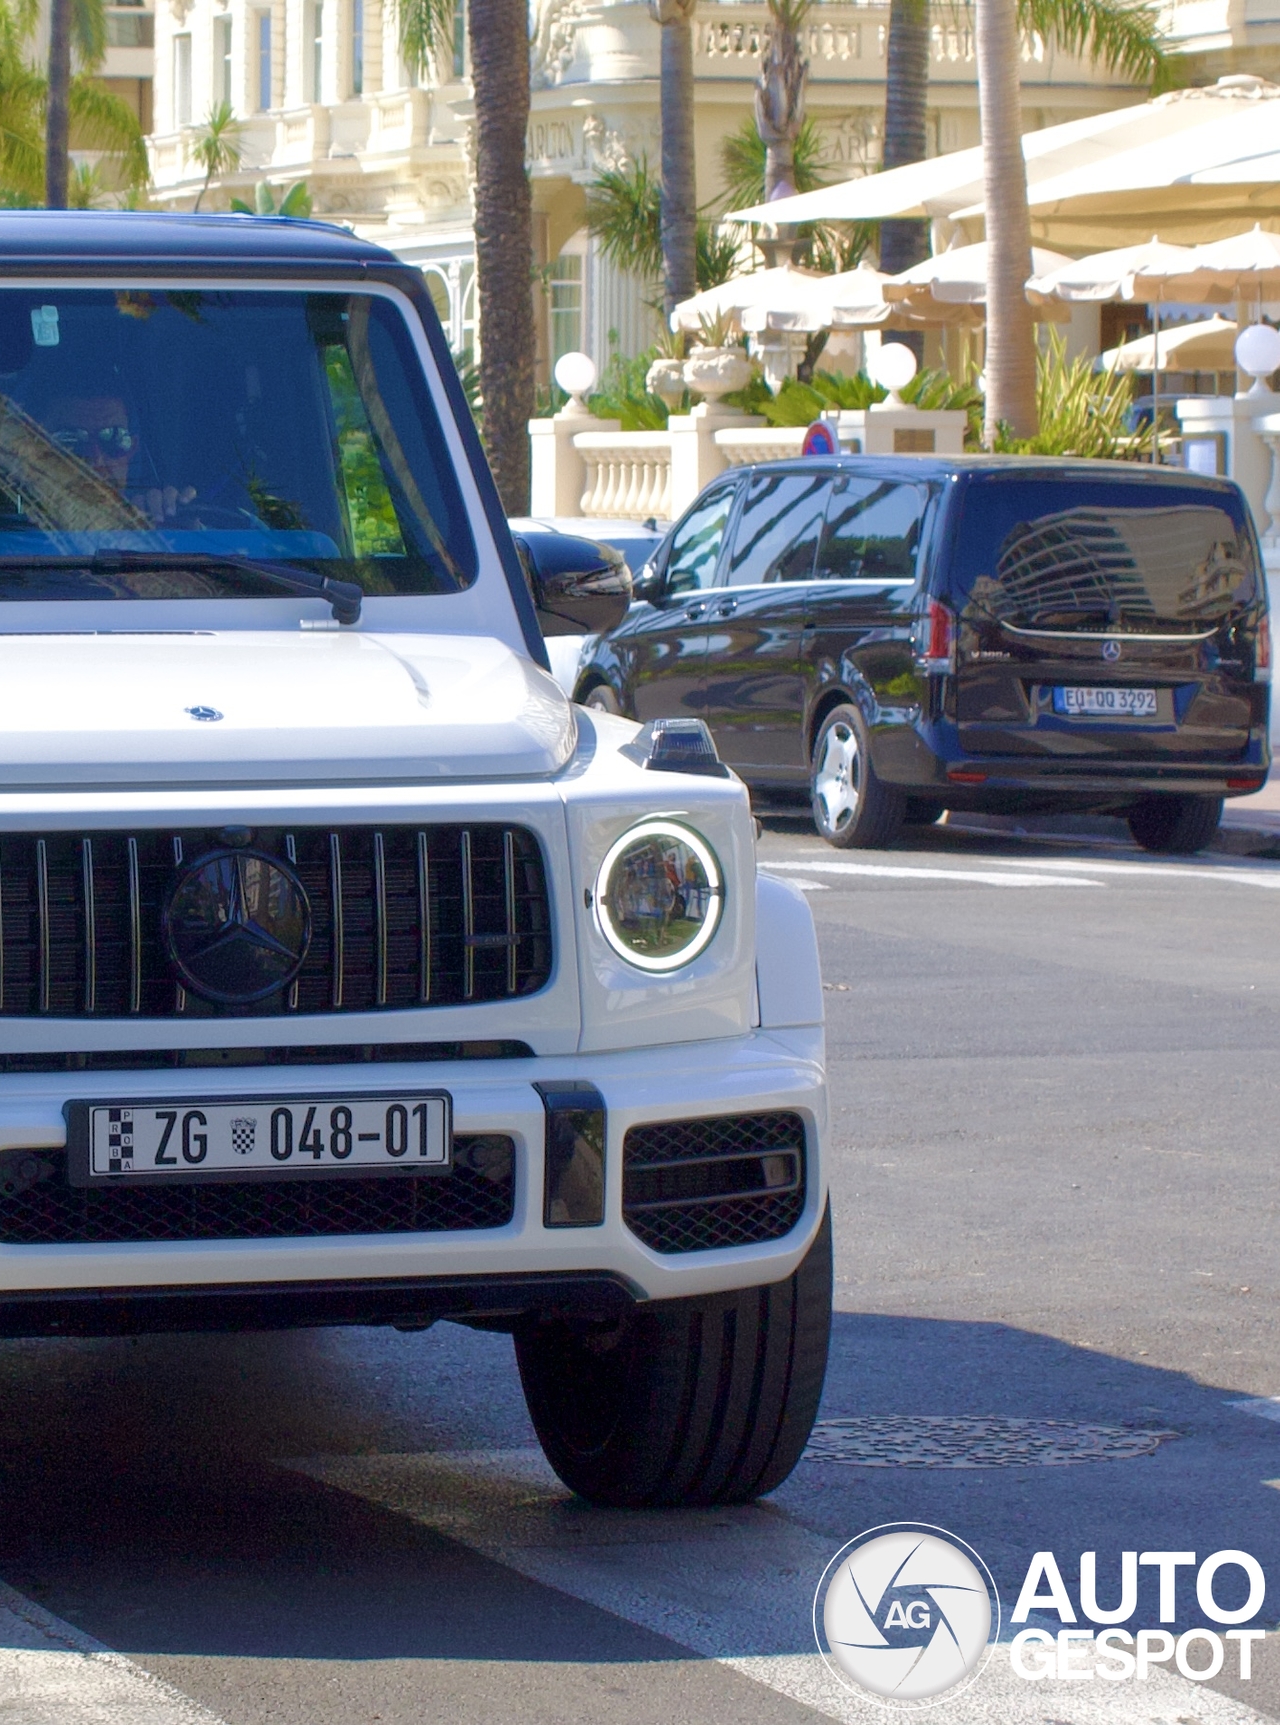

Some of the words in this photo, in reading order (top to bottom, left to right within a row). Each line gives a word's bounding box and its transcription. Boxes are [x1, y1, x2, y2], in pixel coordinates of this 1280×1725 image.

[526, 121, 575, 161] ARLTON
[817, 134, 877, 160] CARL
[1118, 691, 1156, 709] 3292
[154, 1110, 208, 1165] ZG
[270, 1103, 428, 1161] 048-01
